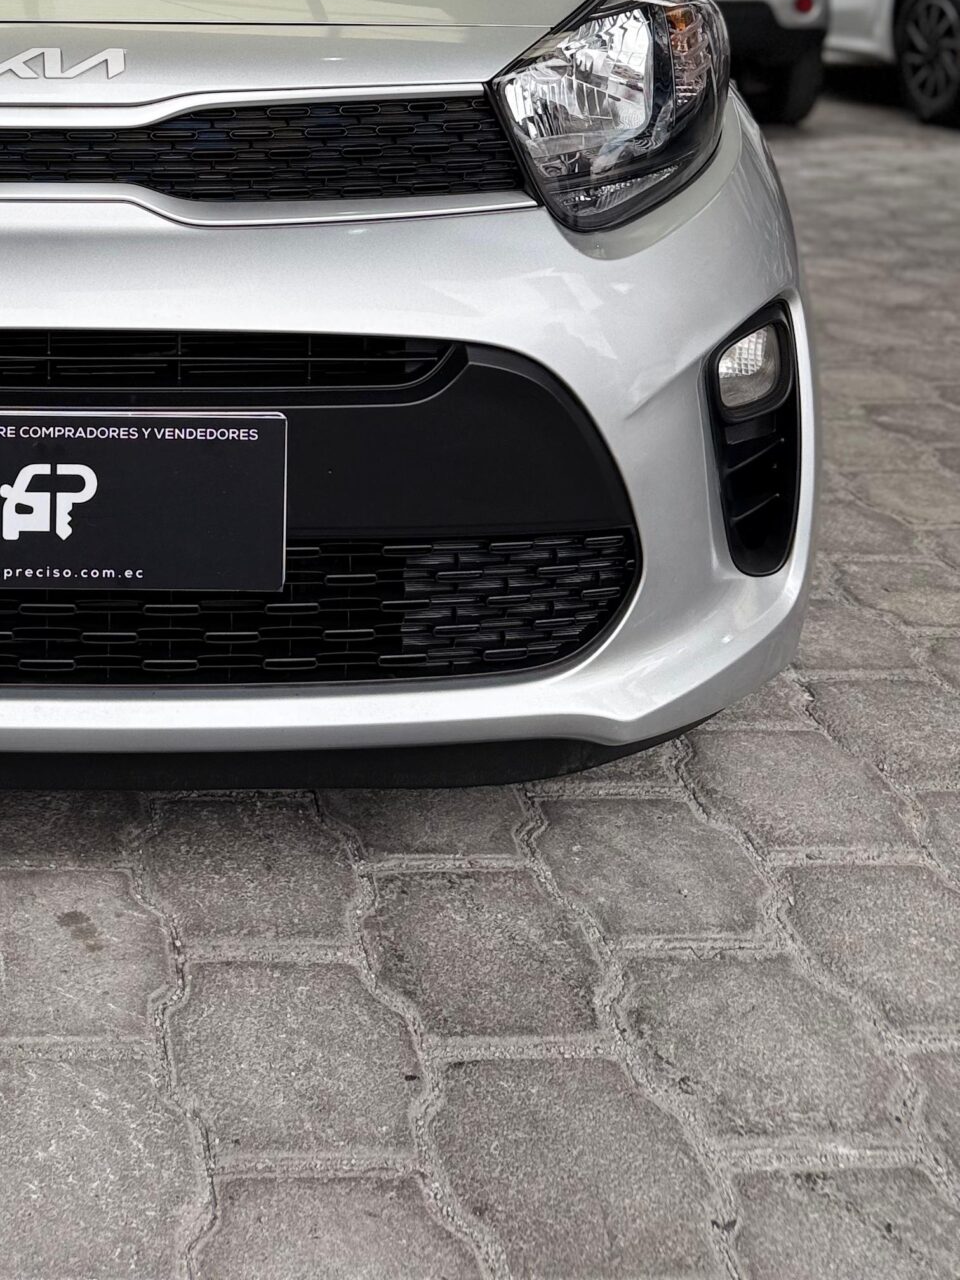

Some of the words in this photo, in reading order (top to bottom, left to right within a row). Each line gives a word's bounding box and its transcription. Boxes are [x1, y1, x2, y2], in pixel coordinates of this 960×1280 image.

[19, 425, 139, 440] COMPRADORES
[141, 426, 152, 440] Y
[153, 426, 259, 441] VENDEDORES
